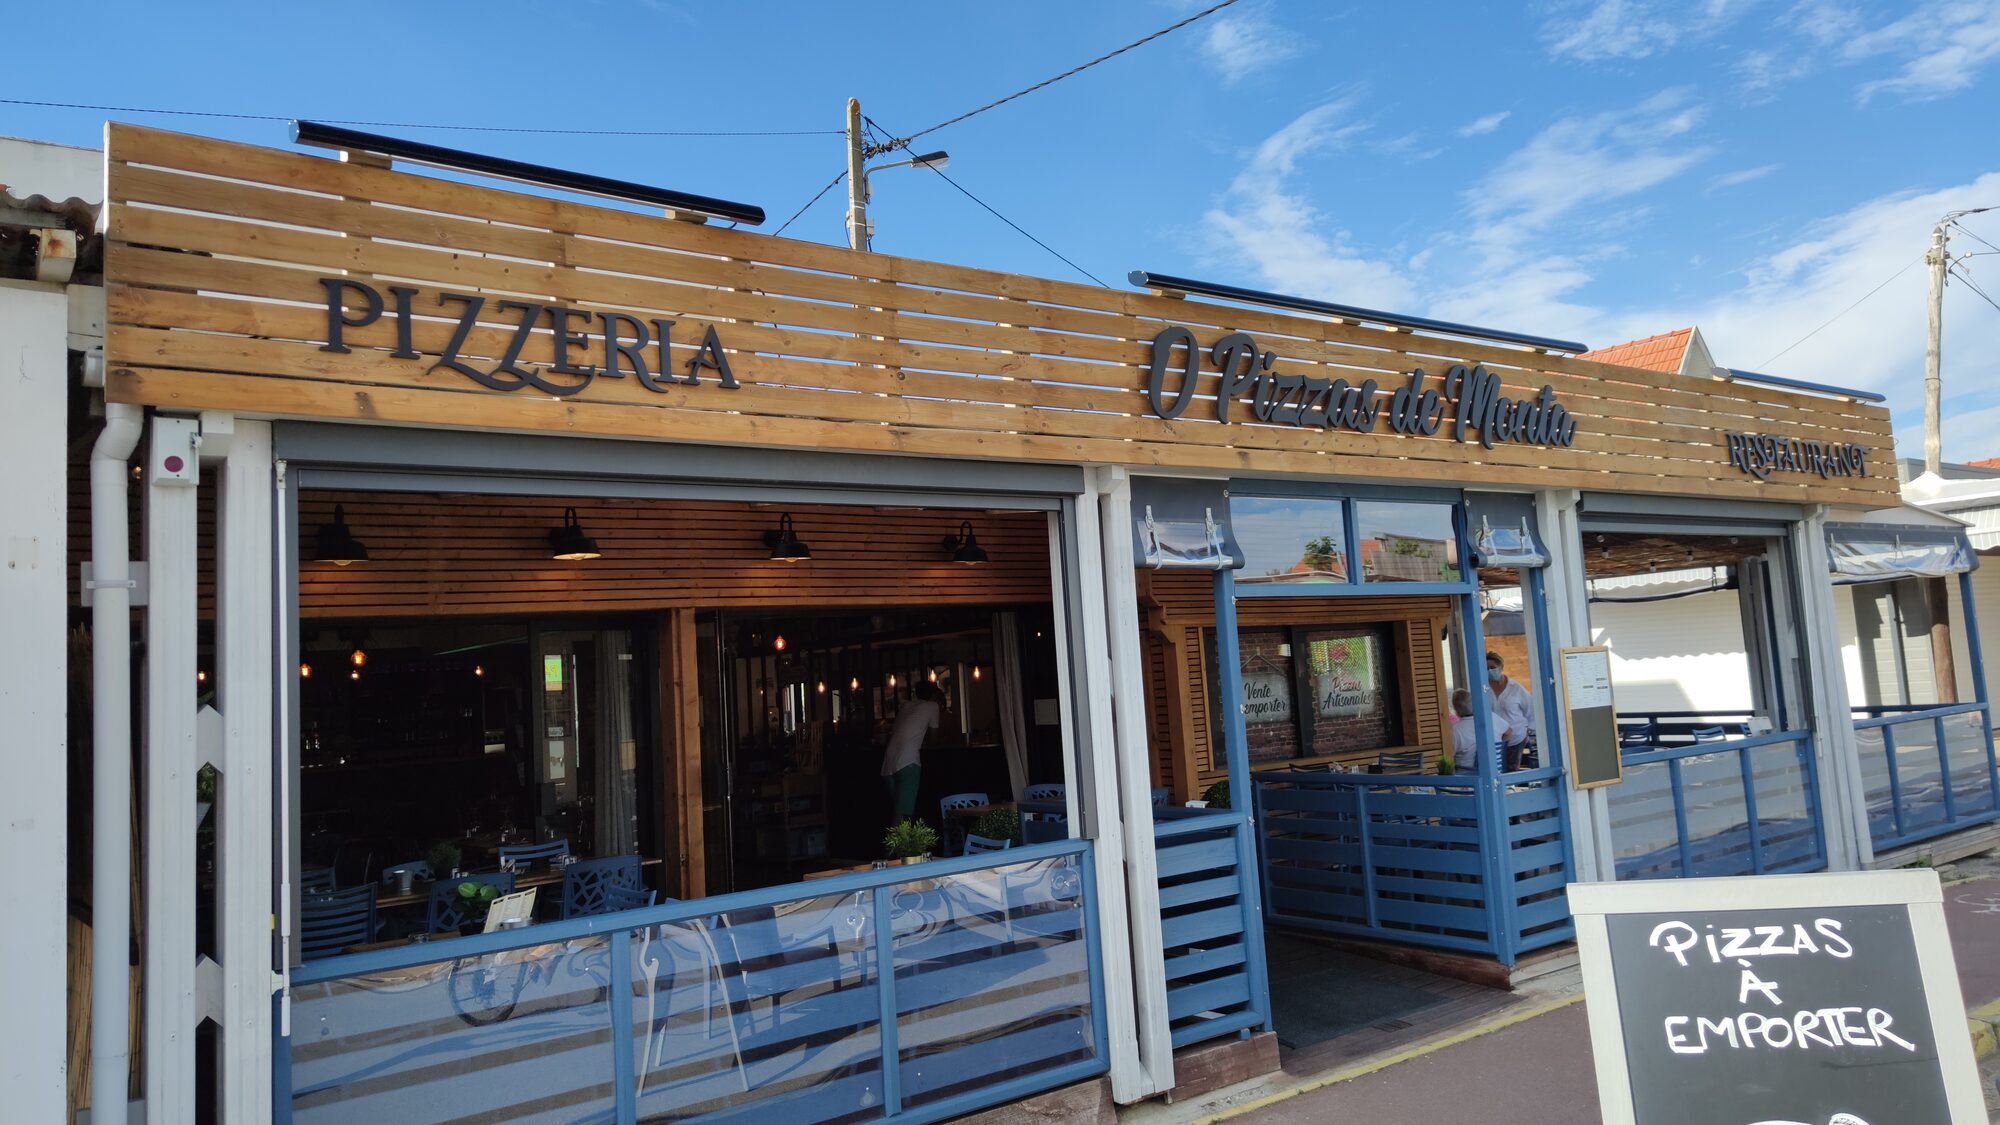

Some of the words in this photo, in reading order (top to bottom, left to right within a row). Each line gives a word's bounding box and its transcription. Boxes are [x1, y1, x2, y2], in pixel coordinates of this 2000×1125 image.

[319, 278, 741, 396] PIZZERIA
[1148, 325, 1199, 421] O
[1211, 333, 1383, 434] Pizzas
[1390, 367, 1445, 436] de
[1444, 364, 1577, 450] Monta
[1726, 431, 1873, 480] RESTAURANT
[1244, 681, 1271, 700] Vente
[1244, 698, 1286, 718] emporter
[1322, 691, 1372, 710] Artisanales
[1738, 959, 1783, 1005] À
[1664, 1007, 1916, 1054] EMPORTER
